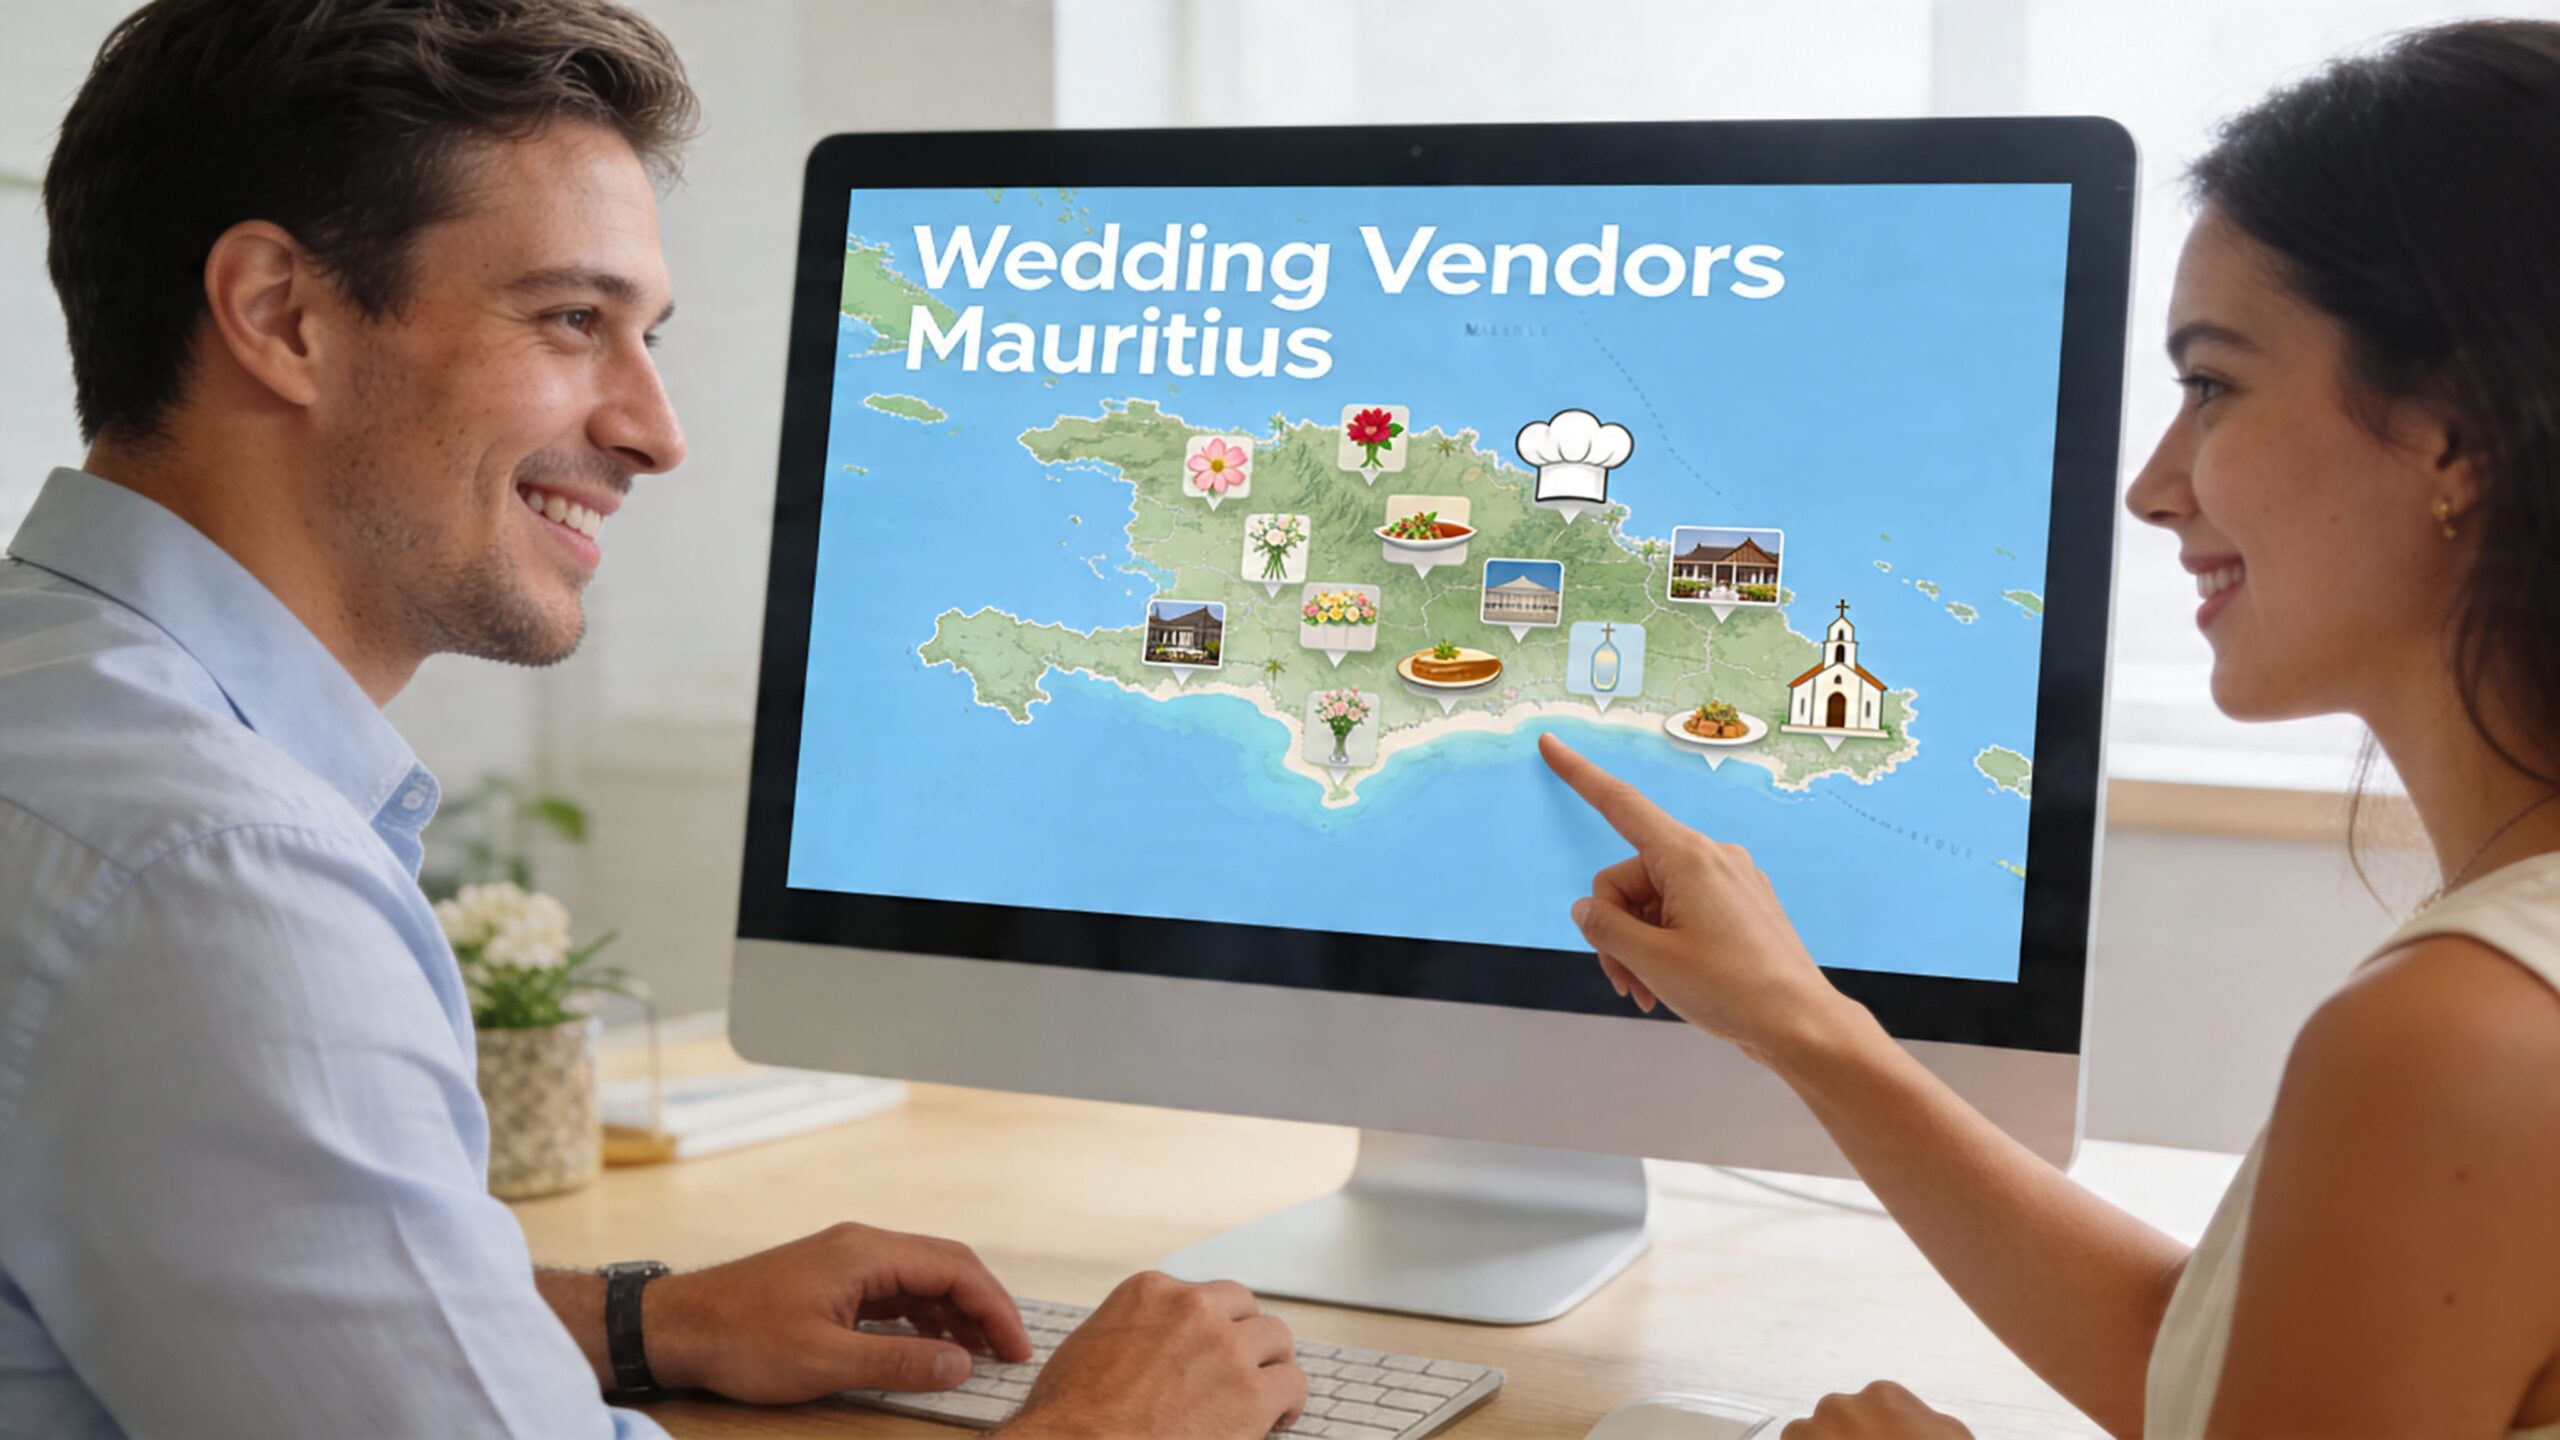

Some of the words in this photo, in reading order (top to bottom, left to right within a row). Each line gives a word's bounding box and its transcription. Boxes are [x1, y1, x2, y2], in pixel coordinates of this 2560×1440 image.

[913, 223, 1331, 312] Wedding
[1359, 225, 1786, 299] Vendors
[905, 305, 1333, 379] Mauritius
